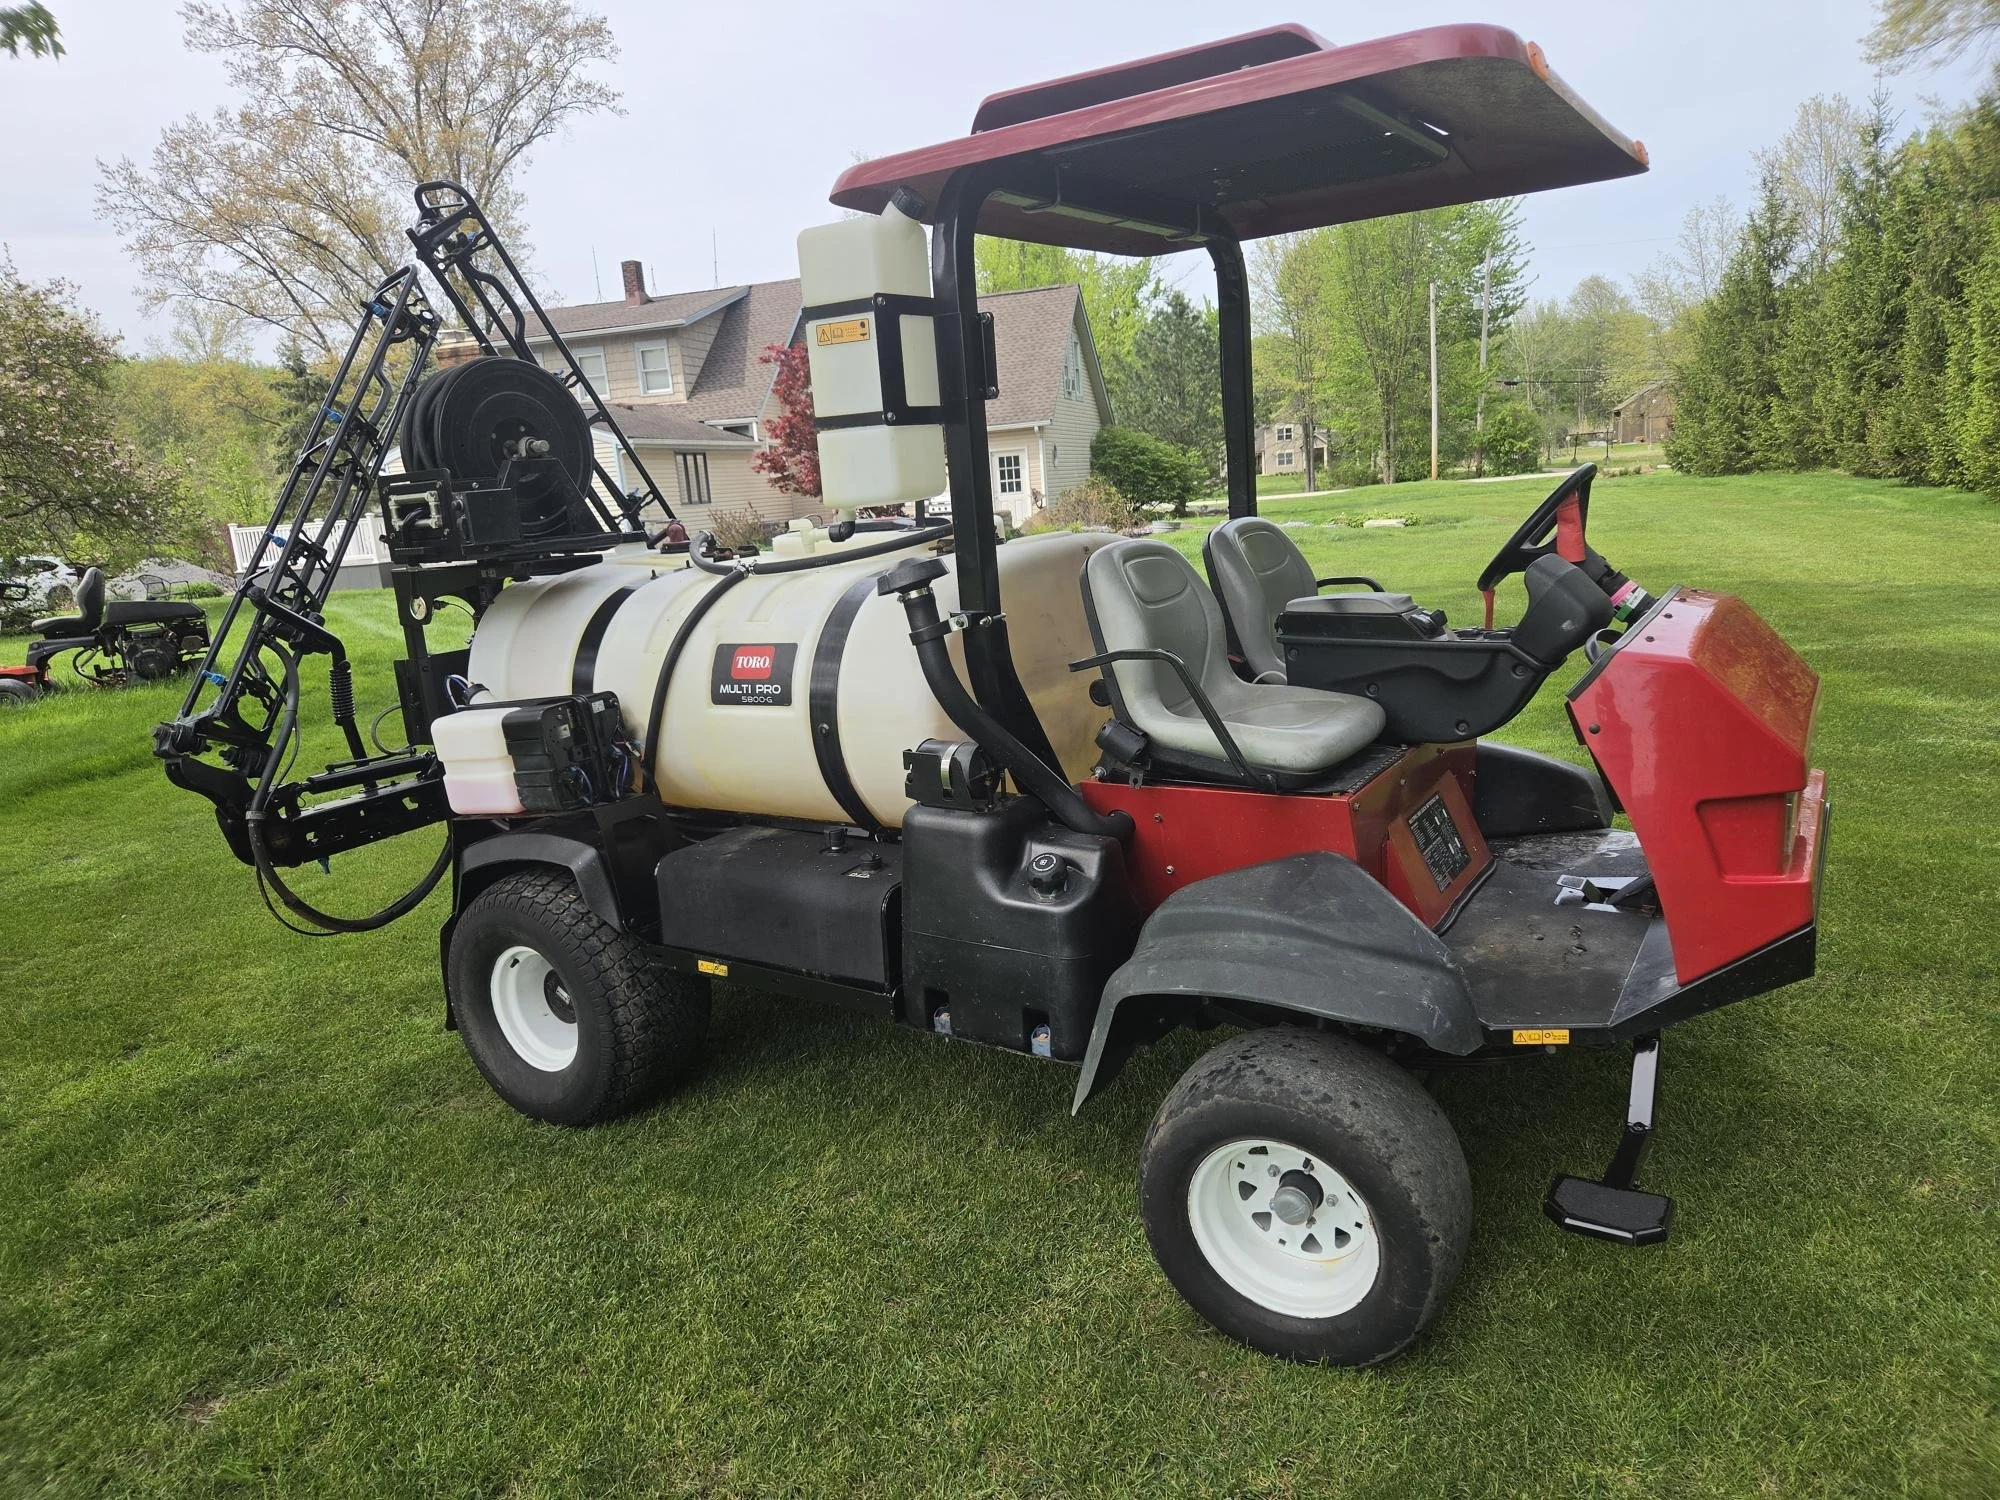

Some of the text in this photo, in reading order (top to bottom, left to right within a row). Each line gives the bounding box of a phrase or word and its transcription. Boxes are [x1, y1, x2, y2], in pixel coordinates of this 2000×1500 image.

[736, 656, 770, 669] TORO
[720, 684, 781, 694] MULTI PRO
